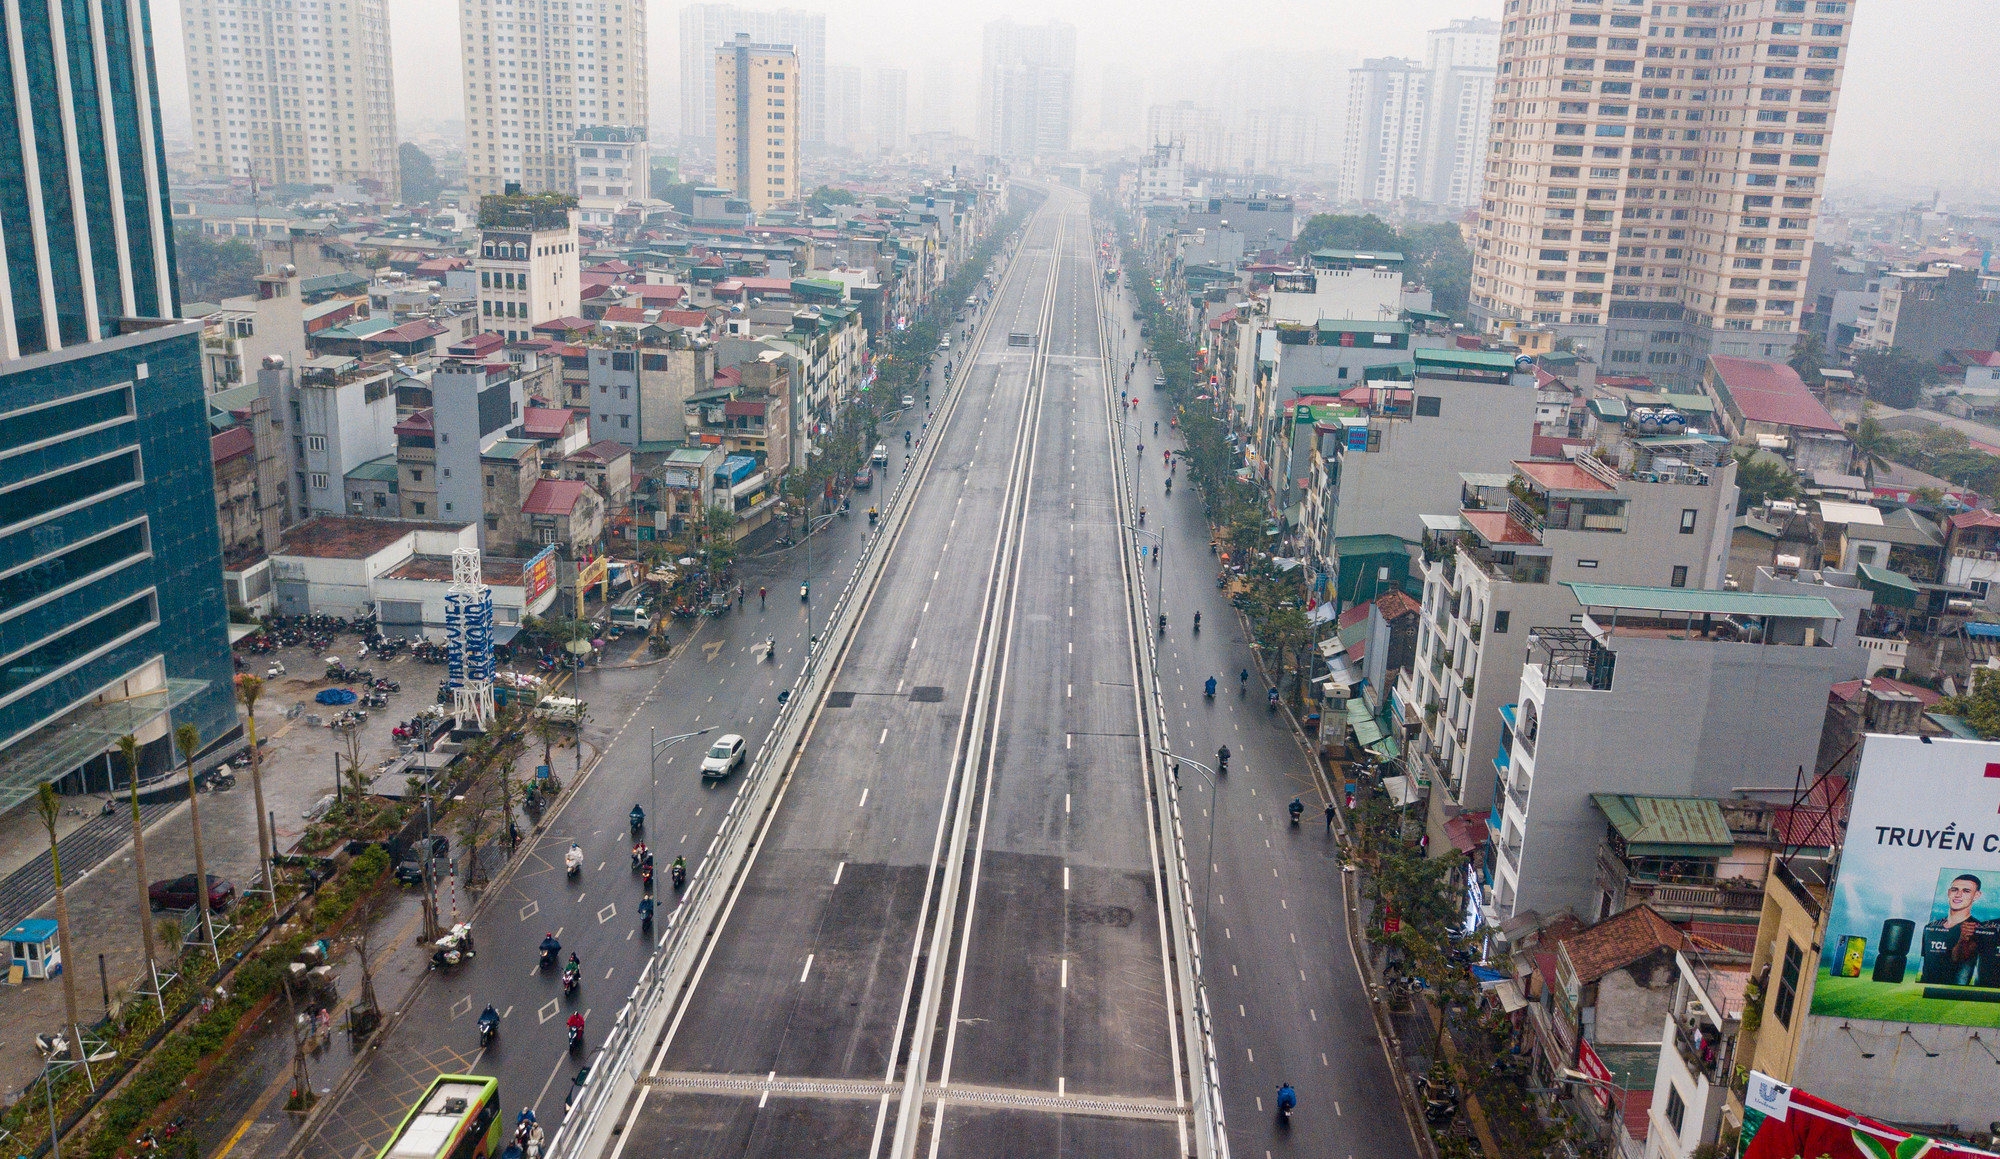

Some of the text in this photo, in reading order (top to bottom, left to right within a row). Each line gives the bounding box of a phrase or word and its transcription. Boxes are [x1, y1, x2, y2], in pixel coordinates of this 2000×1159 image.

[1875, 821, 2000, 853] TRUYỀN C
[1930, 941, 1948, 950] TCL
